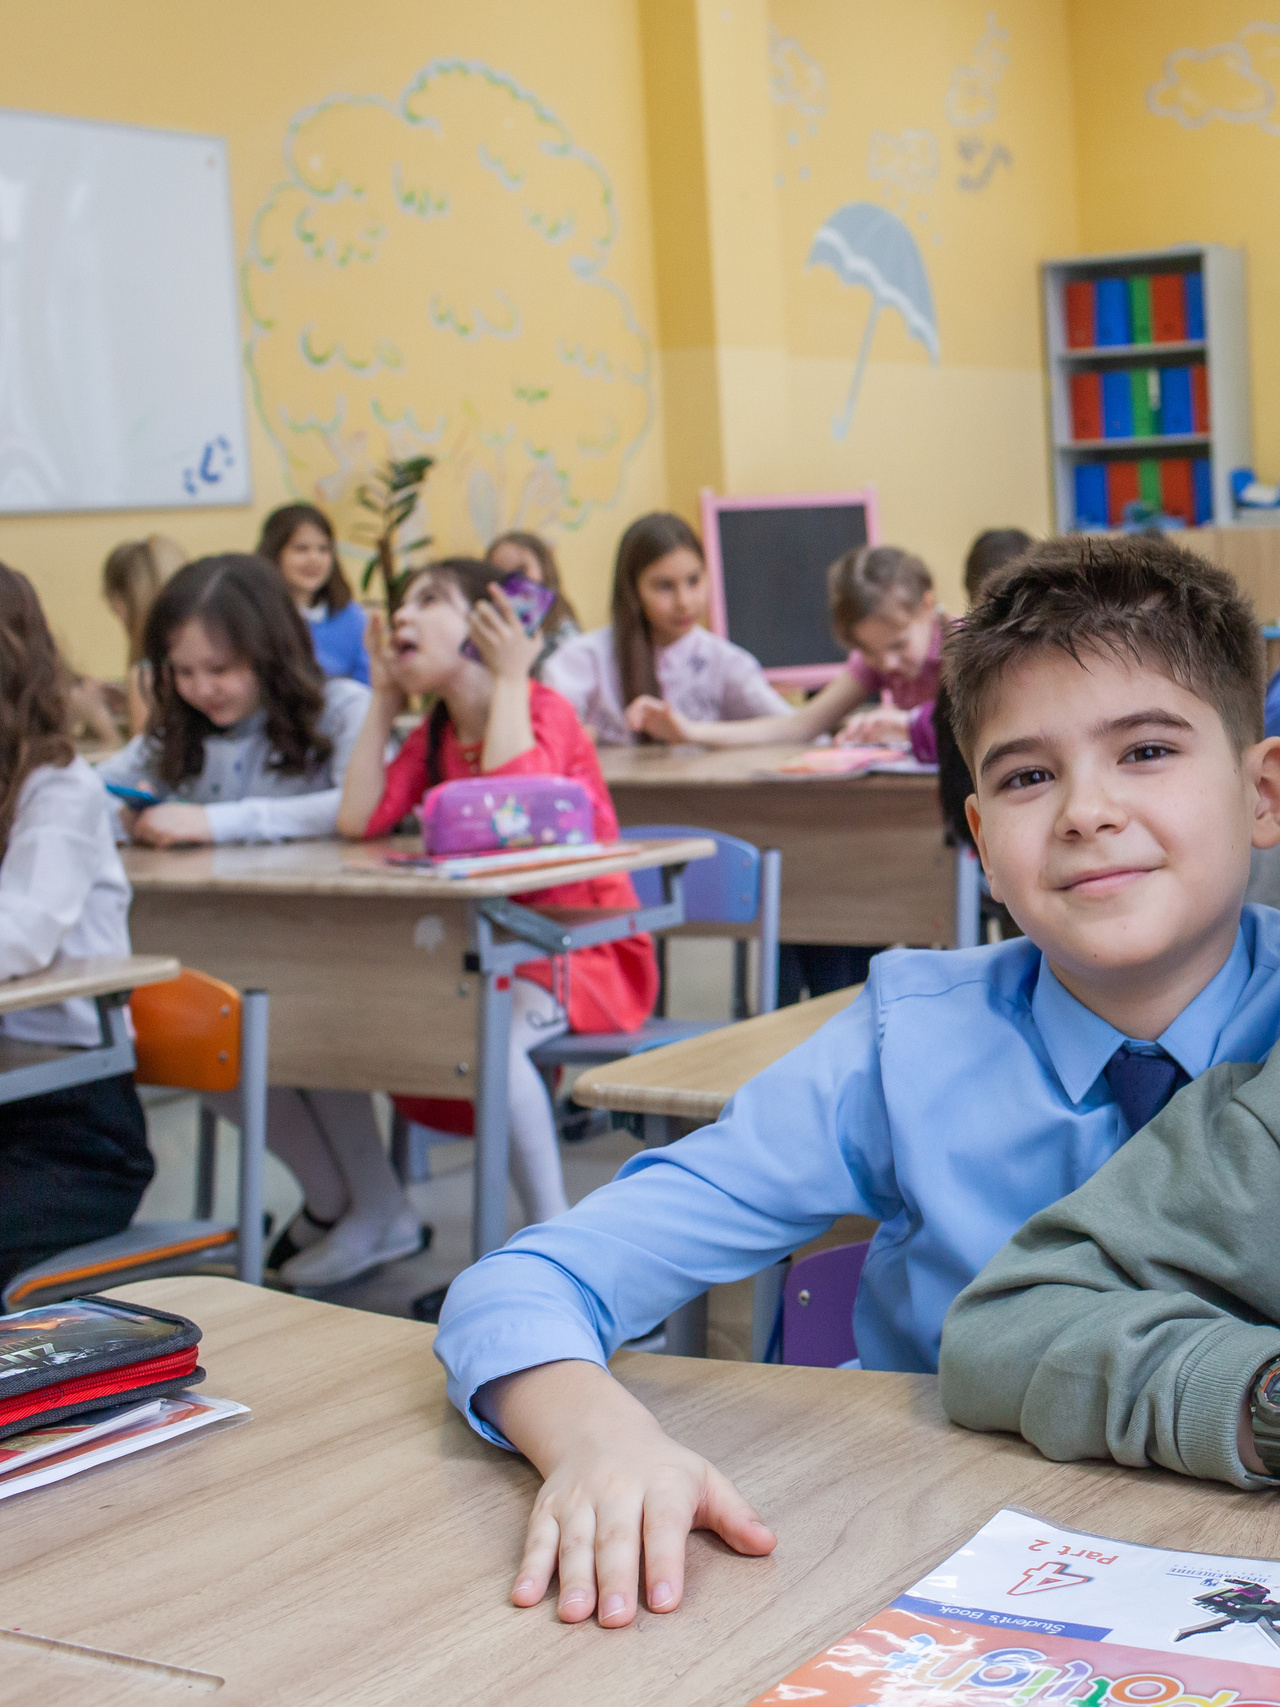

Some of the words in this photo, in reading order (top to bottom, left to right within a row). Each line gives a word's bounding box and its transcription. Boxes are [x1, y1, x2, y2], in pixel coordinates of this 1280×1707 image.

[1028, 1539, 1051, 1552] 2
[1055, 1544, 1119, 1566] Part
[1006, 1561, 1092, 1597] 4
[938, 1605, 984, 1621] Book
[988, 1614, 1066, 1634] Student's
